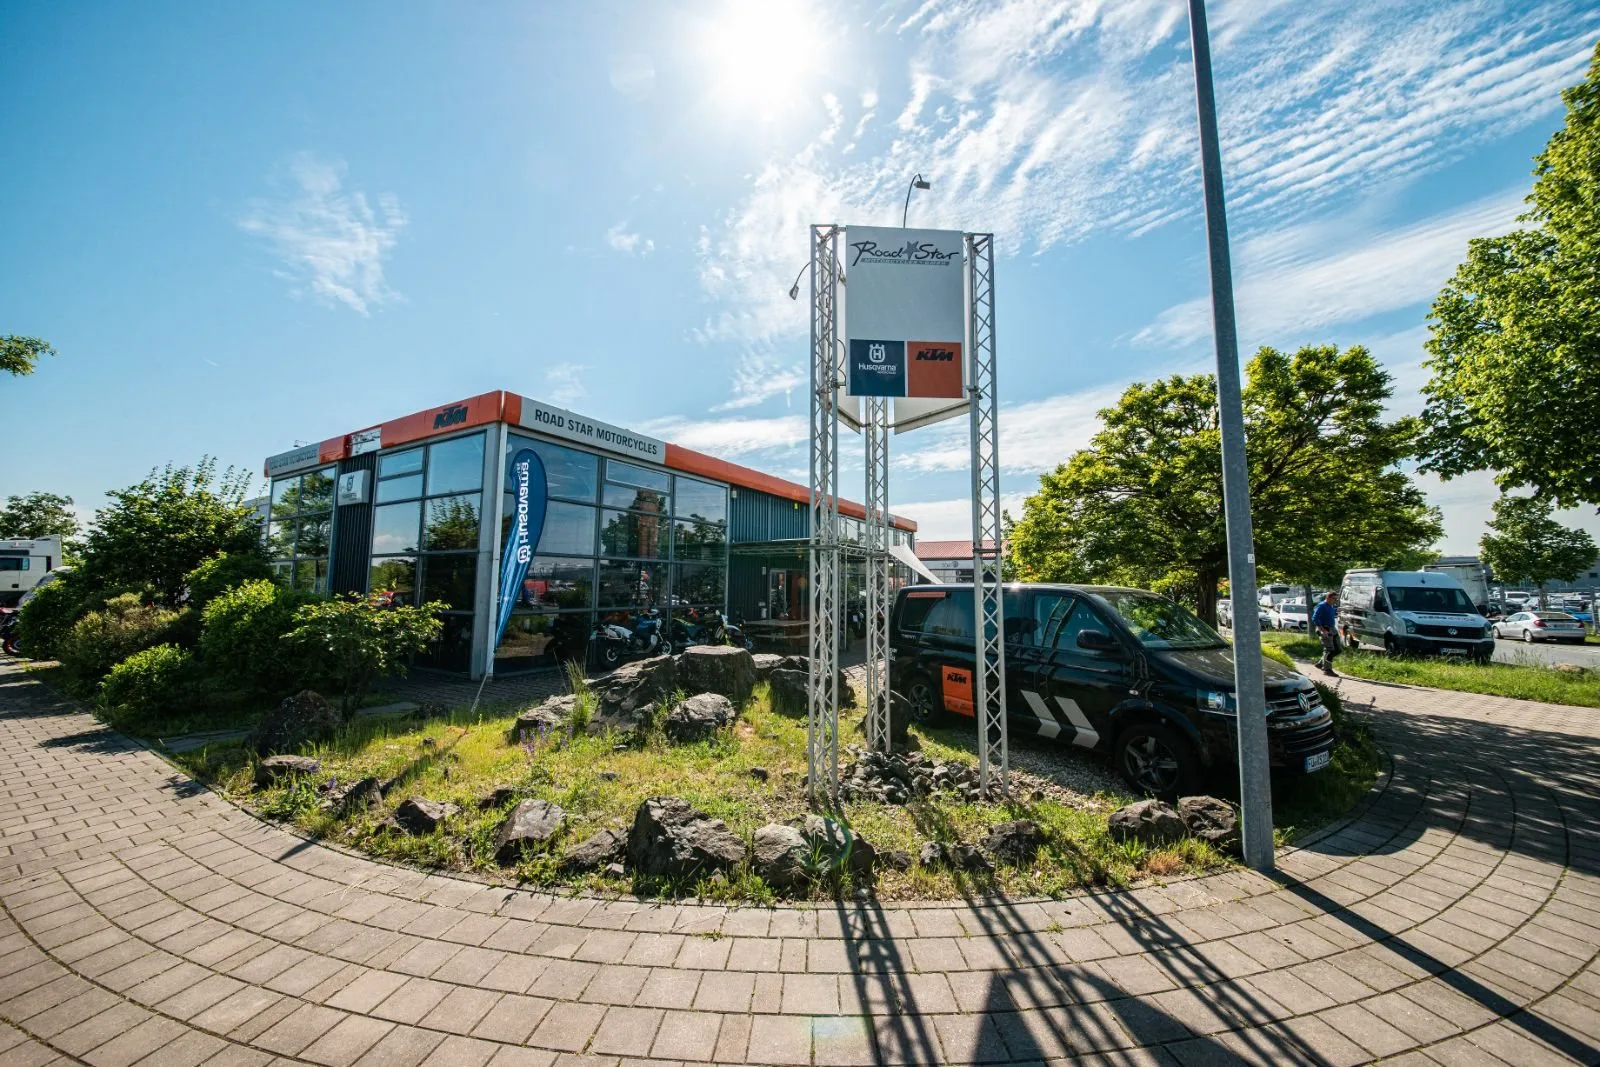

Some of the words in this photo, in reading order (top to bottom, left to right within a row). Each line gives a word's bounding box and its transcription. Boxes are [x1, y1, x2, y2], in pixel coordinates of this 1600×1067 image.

[850, 241, 903, 266] Road
[915, 244, 959, 260] Star
[916, 348, 954, 362] KTM
[858, 362, 897, 372] Husqvarna
[432, 404, 469, 429] KTM
[535, 408, 565, 428] ROAD
[567, 419, 594, 437] STAR
[596, 427, 658, 455] MOTORCYCLES
[946, 672, 967, 684] KTM
